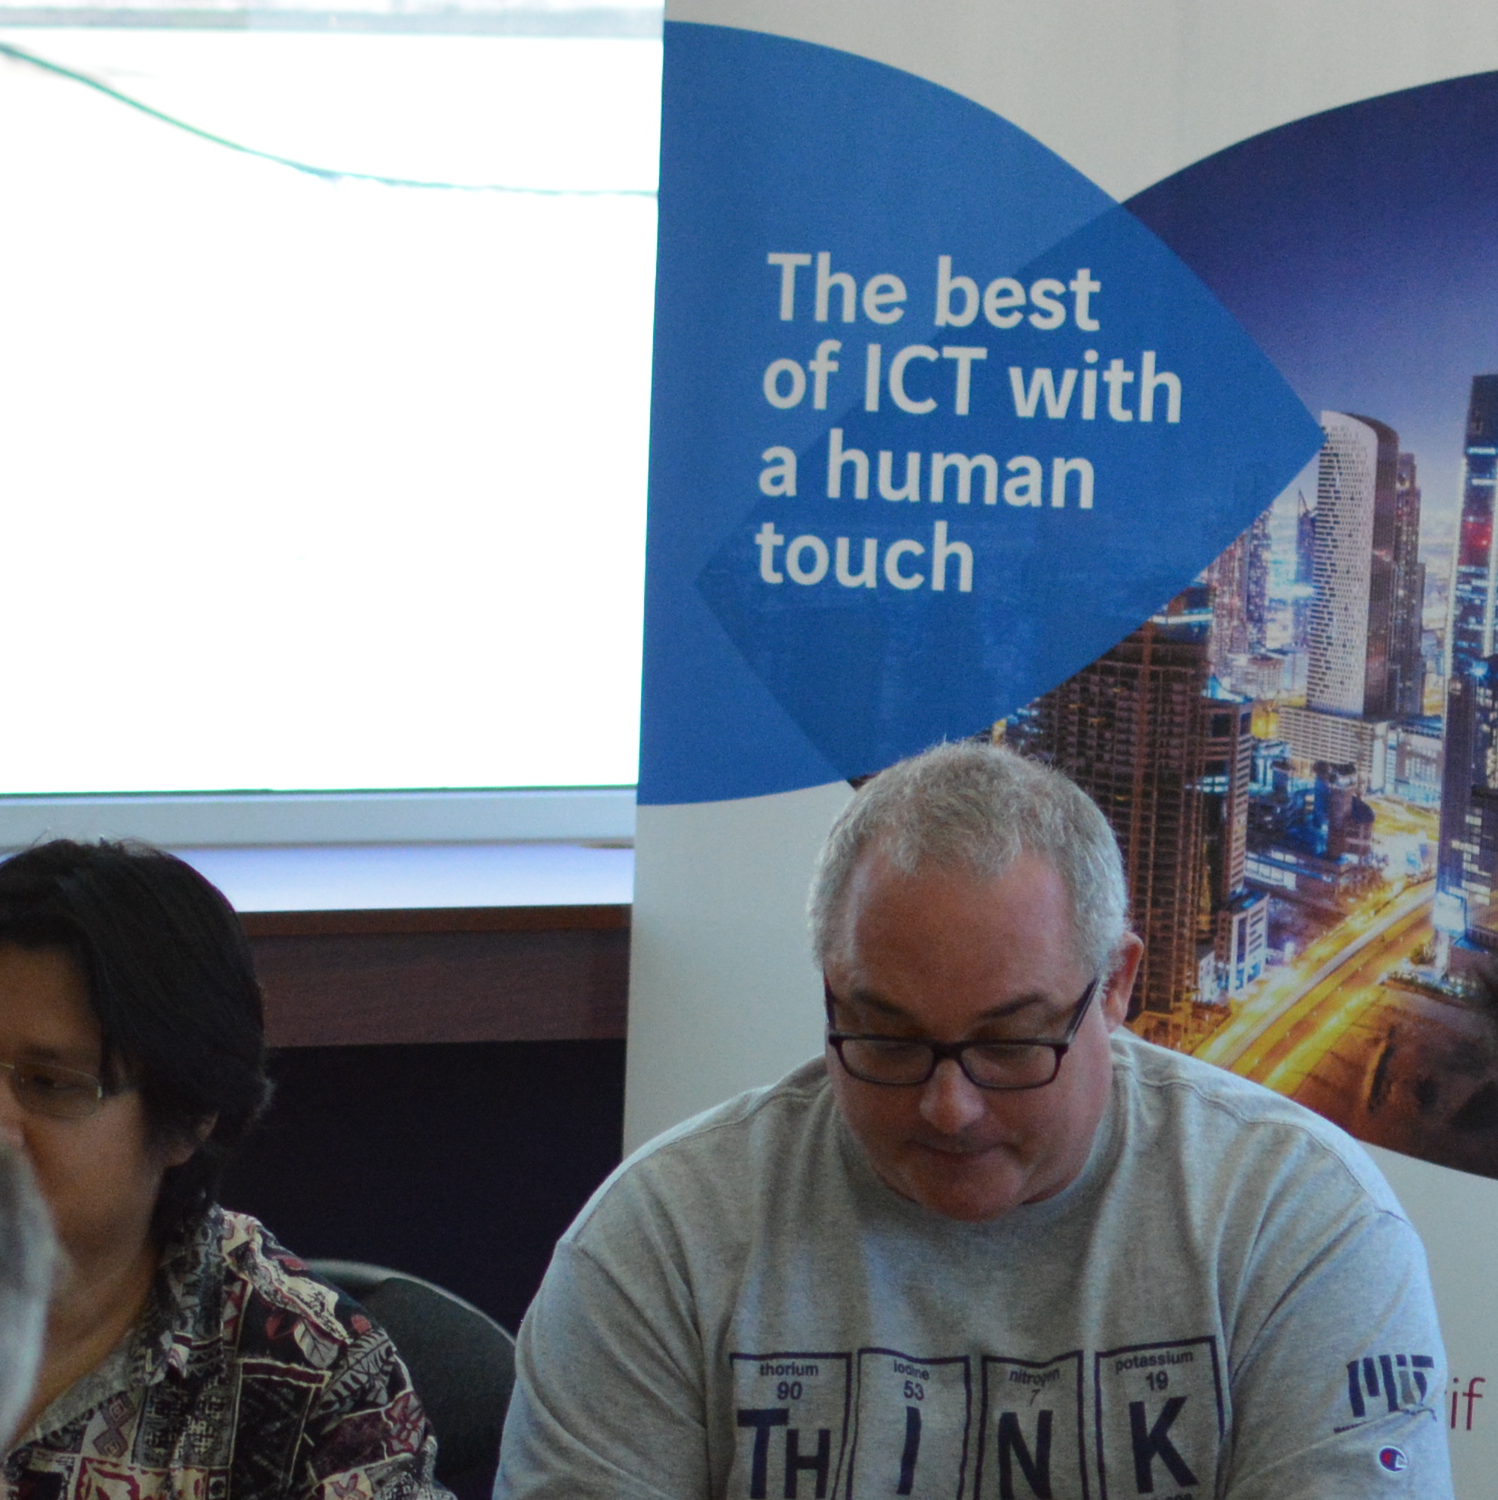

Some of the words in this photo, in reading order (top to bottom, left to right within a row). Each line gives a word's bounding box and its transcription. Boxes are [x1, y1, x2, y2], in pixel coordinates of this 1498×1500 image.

[767, 251, 907, 324] The
[934, 255, 1101, 331] best
[763, 339, 842, 410] of
[864, 343, 988, 416] ICT
[1008, 349, 1182, 424] with
[758, 446, 798, 497] a
[827, 428, 1095, 509] human
[755, 521, 973, 593] touch
[759, 1361, 819, 1377] thorium
[893, 1360, 930, 1381] iodine
[1115, 1350, 1194, 1374] potassium
[1009, 1366, 1060, 1388] nitrogen
[1145, 1371, 1169, 1391] 19
[776, 1381, 804, 1401] 90
[903, 1380, 925, 1401] 53
[1447, 1376, 1486, 1431] if
[737, 1407, 831, 1500] TH
[896, 1405, 922, 1496] I
[998, 1409, 1053, 1500] N
[1129, 1396, 1199, 1494] K
